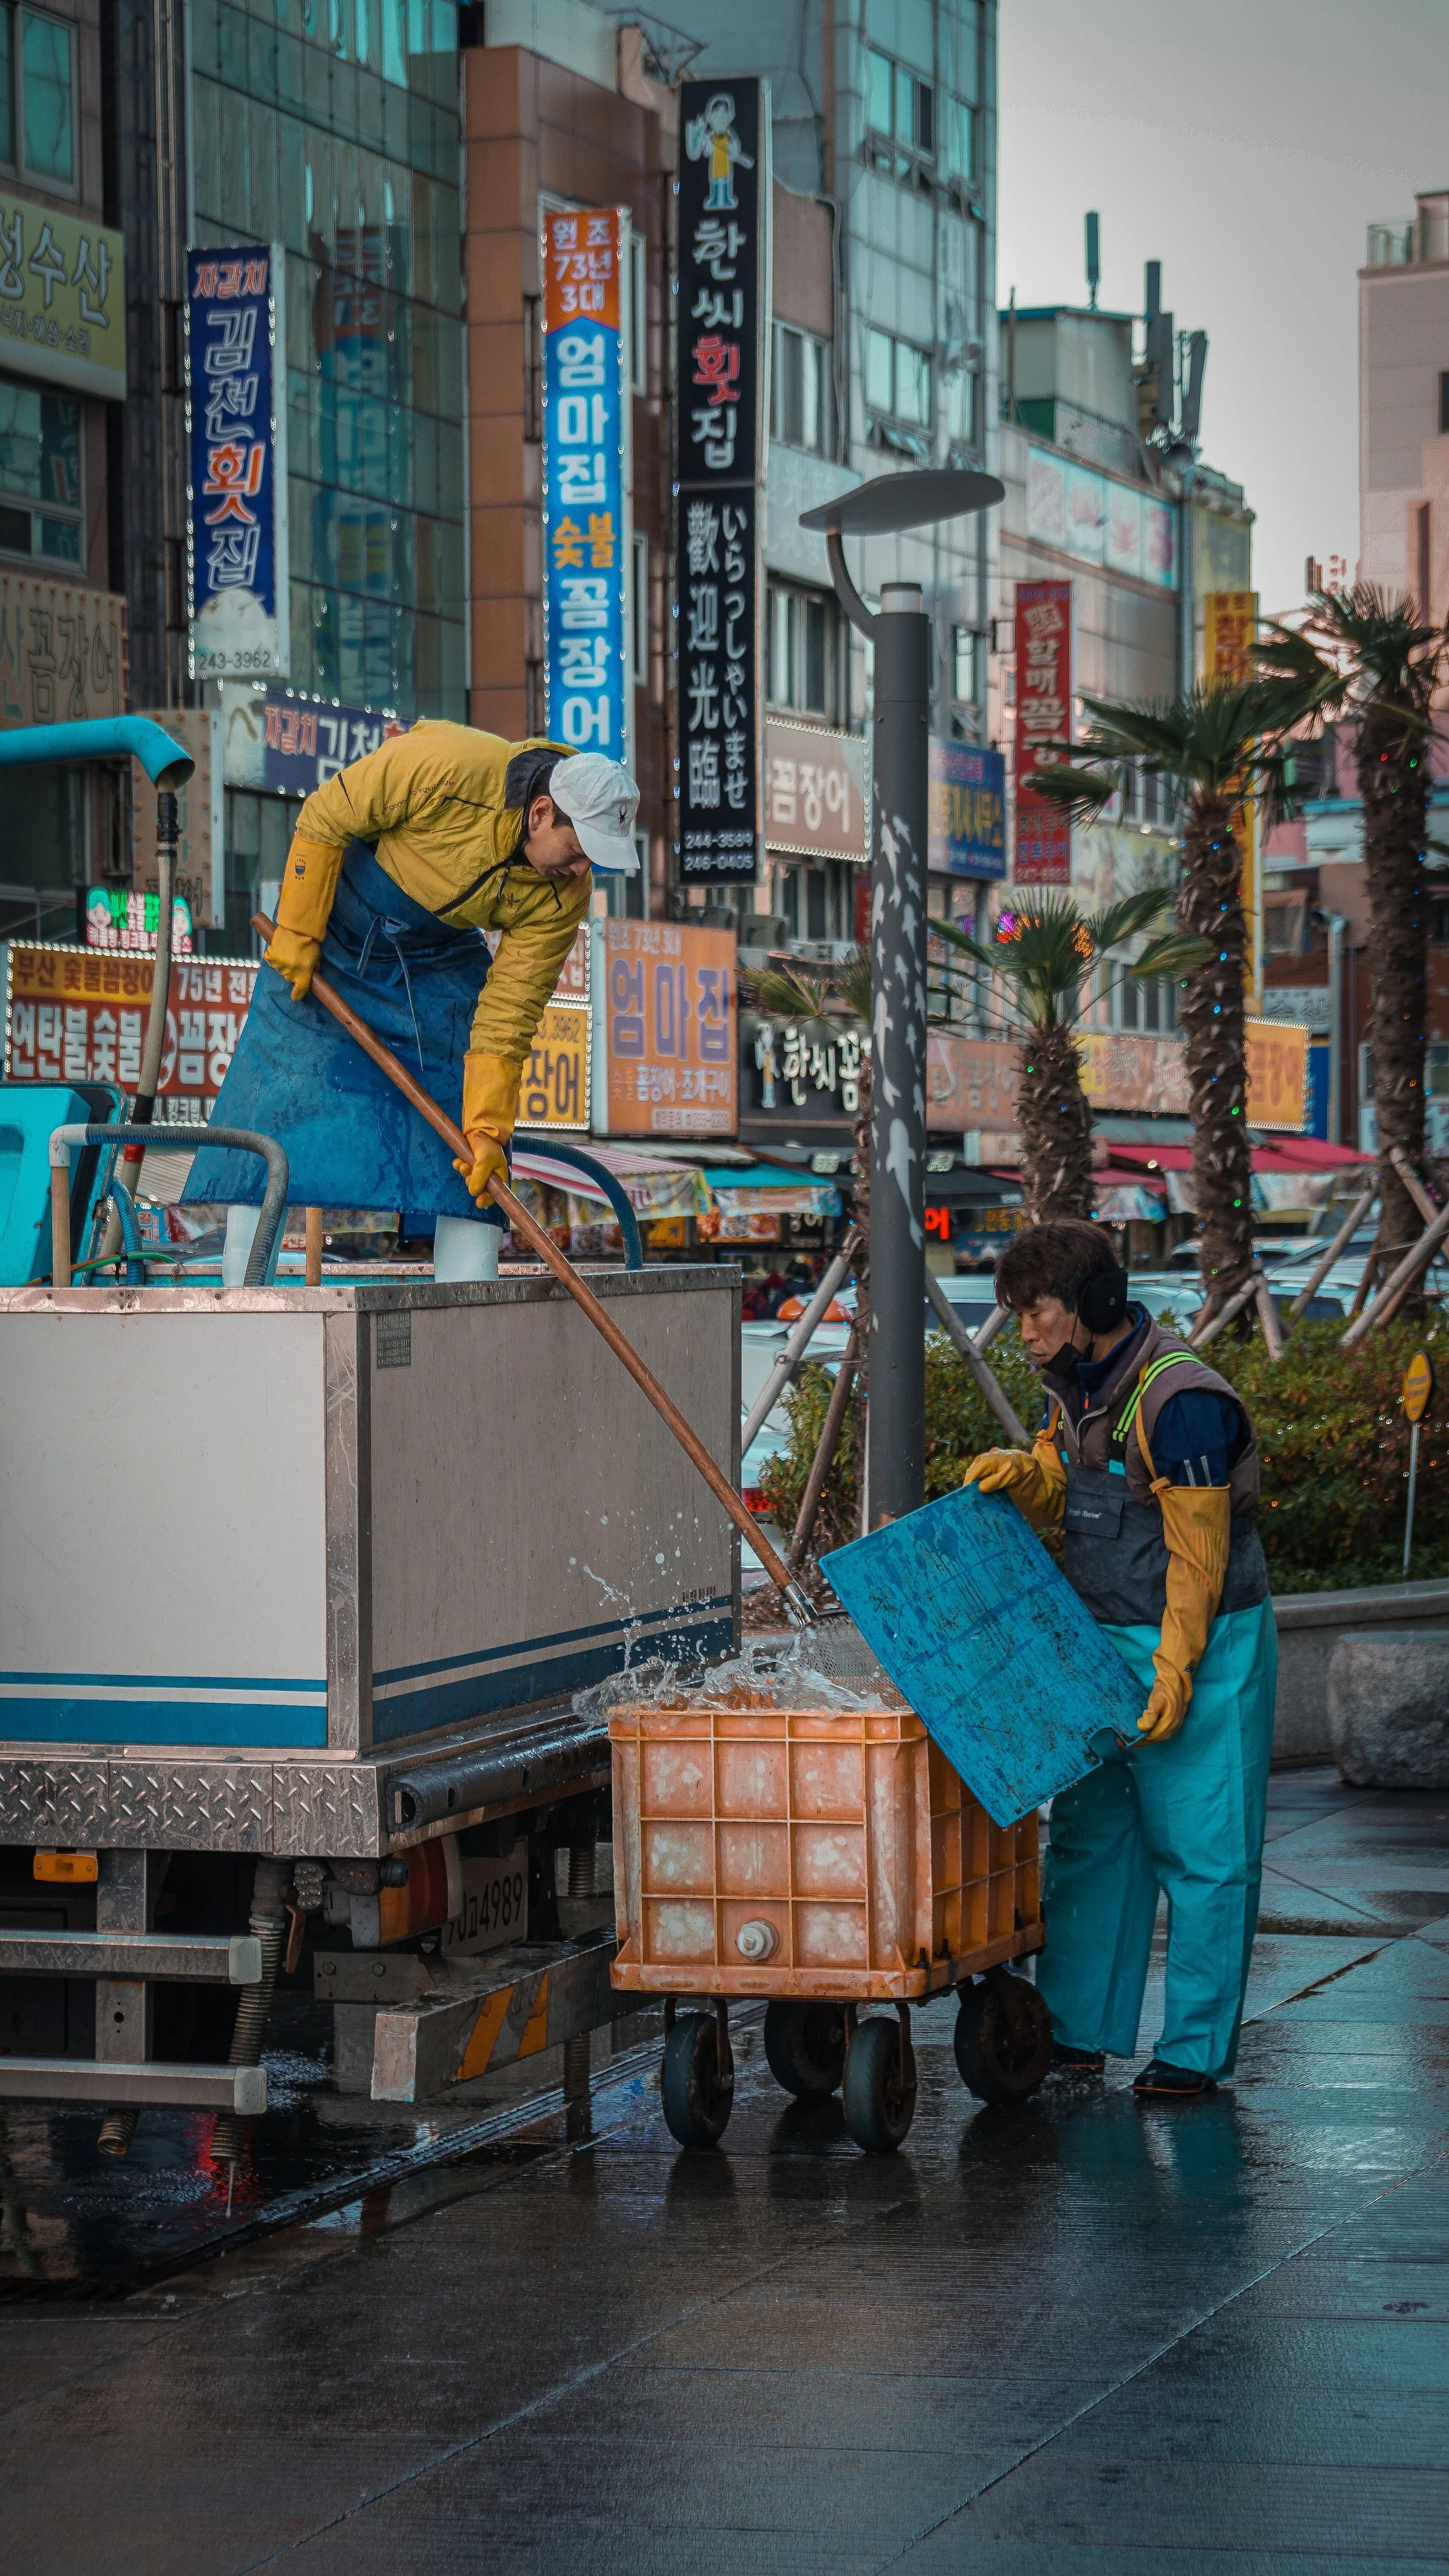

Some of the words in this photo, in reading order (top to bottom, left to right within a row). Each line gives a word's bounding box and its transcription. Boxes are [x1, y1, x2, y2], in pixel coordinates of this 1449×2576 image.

[193, 260, 267, 298] 자갈치
[553, 252, 612, 282] 73년
[560, 282, 606, 313] 3대
[691, 219, 747, 470] 한씨횟집
[203, 308, 265, 590] 김천횟집
[556, 335, 610, 506] 엄마집
[552, 511, 616, 570] 숯불
[198, 650, 271, 671] 243-3962
[722, 503, 748, 810] いらっしゃいませ
[264, 705, 318, 757] 자갈치
[316, 717, 404, 784] 김천
[767, 754, 851, 834] 꼼장어
[17, 954, 56, 988] 부산
[178, 966, 223, 1003] 75년
[610, 957, 731, 1064] 엄마집
[12, 1003, 143, 1083] 연탄불,숯불
[179, 1011, 248, 1088] 꼼장
